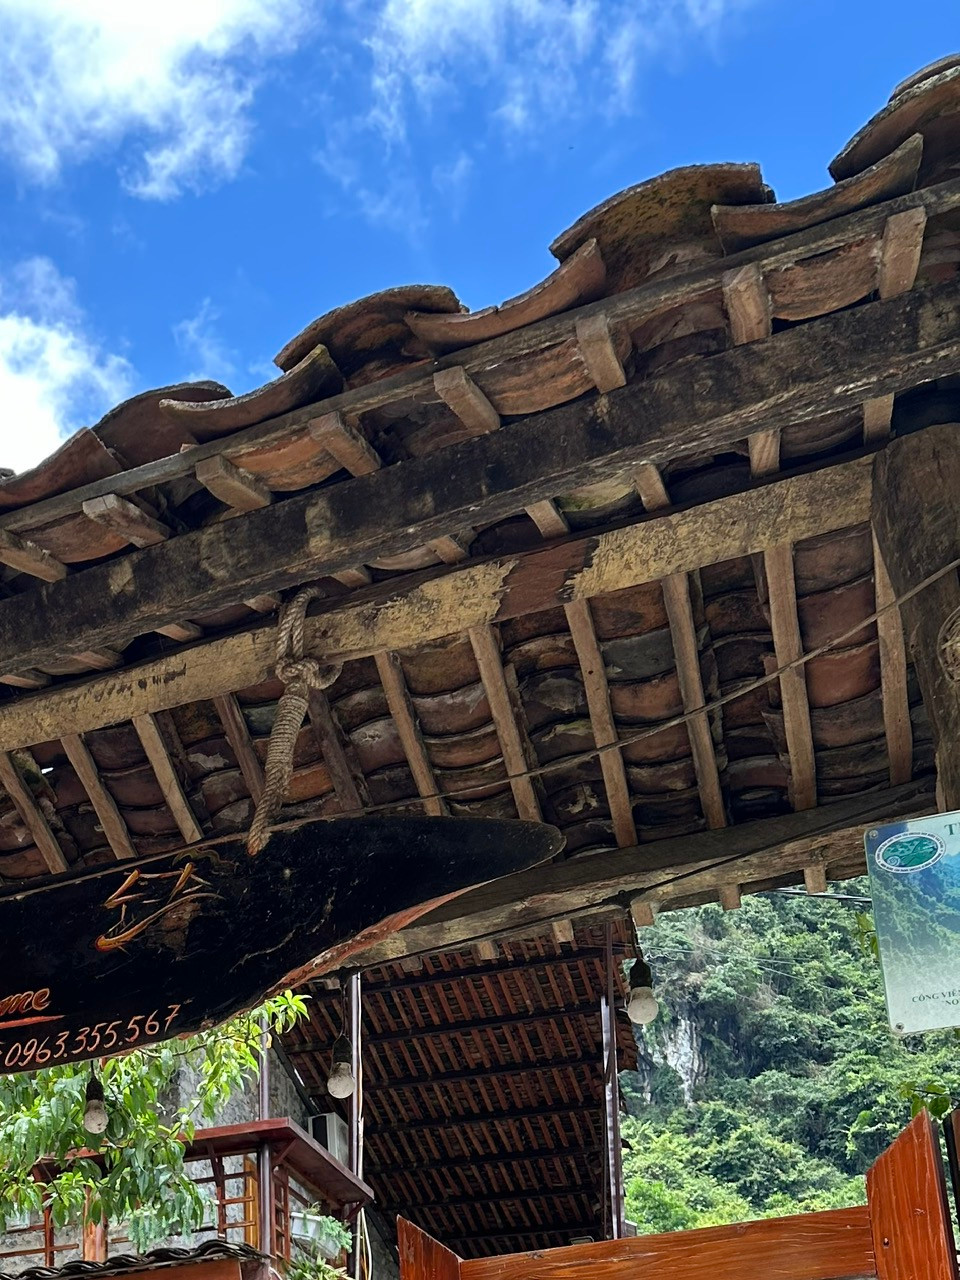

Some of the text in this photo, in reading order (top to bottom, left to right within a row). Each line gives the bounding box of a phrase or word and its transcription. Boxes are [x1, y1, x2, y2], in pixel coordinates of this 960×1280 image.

[944, 822, 960, 836] T
[911, 988, 960, 1003] CÔNG VIÊ
